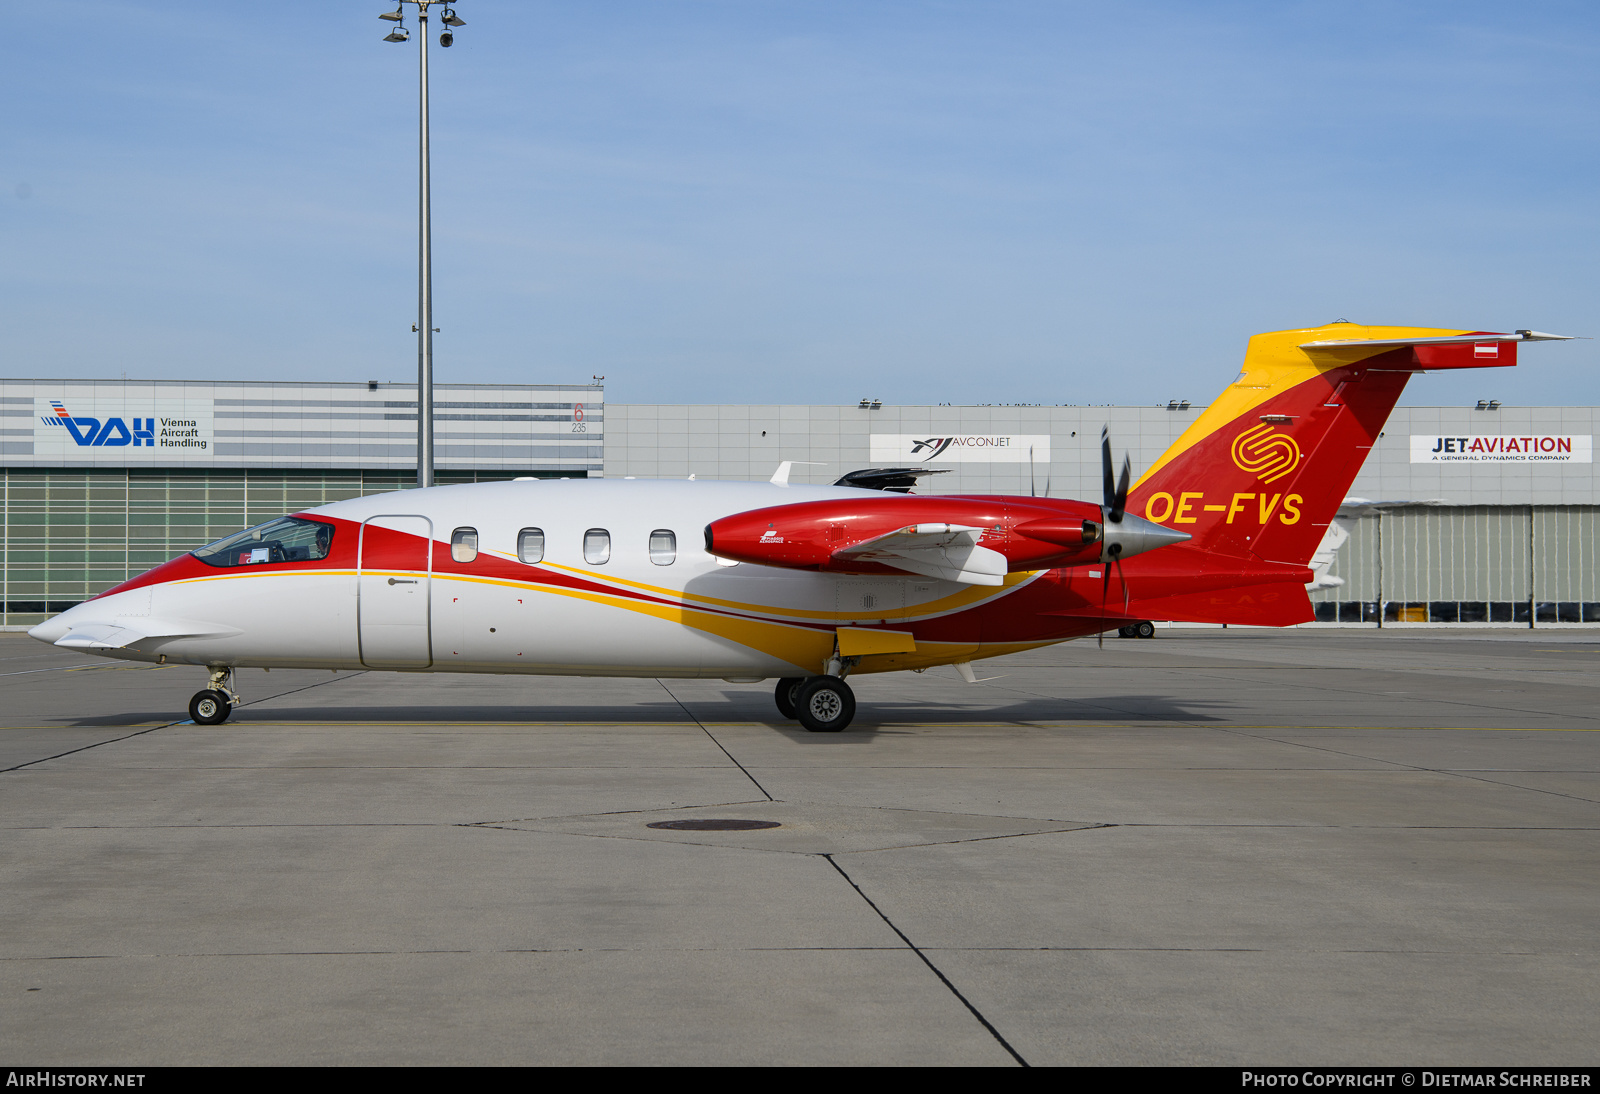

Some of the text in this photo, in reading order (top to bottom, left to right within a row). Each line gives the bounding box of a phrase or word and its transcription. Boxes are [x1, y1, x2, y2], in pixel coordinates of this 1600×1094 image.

[574, 402, 584, 422] 6
[160, 417, 197, 427] Vienna
[571, 422, 587, 433] 235
[160, 428, 199, 437] Aircraft
[160, 438, 207, 449] Handling
[951, 437, 1011, 446] AVCONJET
[1145, 491, 1304, 525] OE-FVS
